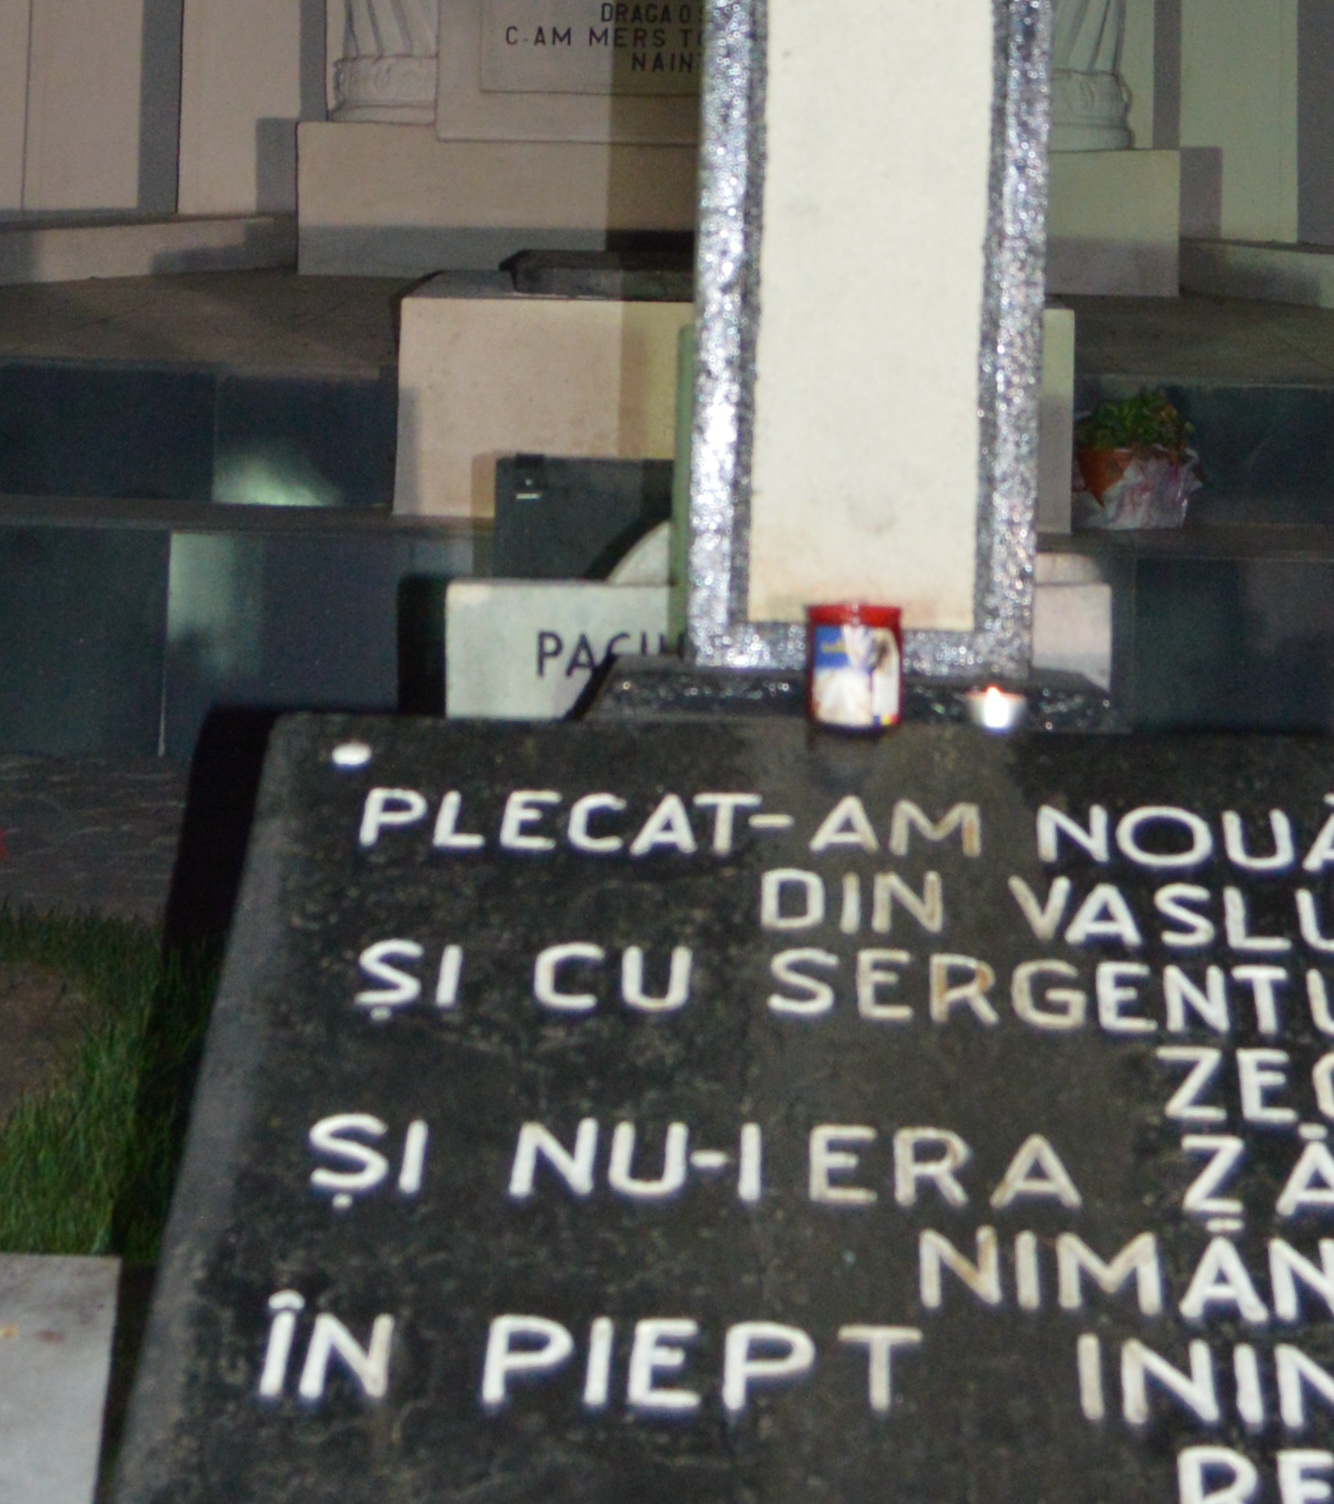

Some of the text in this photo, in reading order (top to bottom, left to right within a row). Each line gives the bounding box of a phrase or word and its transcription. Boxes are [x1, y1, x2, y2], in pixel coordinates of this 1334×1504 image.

[588, 26, 666, 48] MERS
[760, 868, 944, 934] DIN
[532, 942, 693, 1012] CU
[808, 1124, 1082, 1208] ERA
[259, 1288, 395, 1402] ÎN
[481, 1314, 923, 1414] PIEPT
